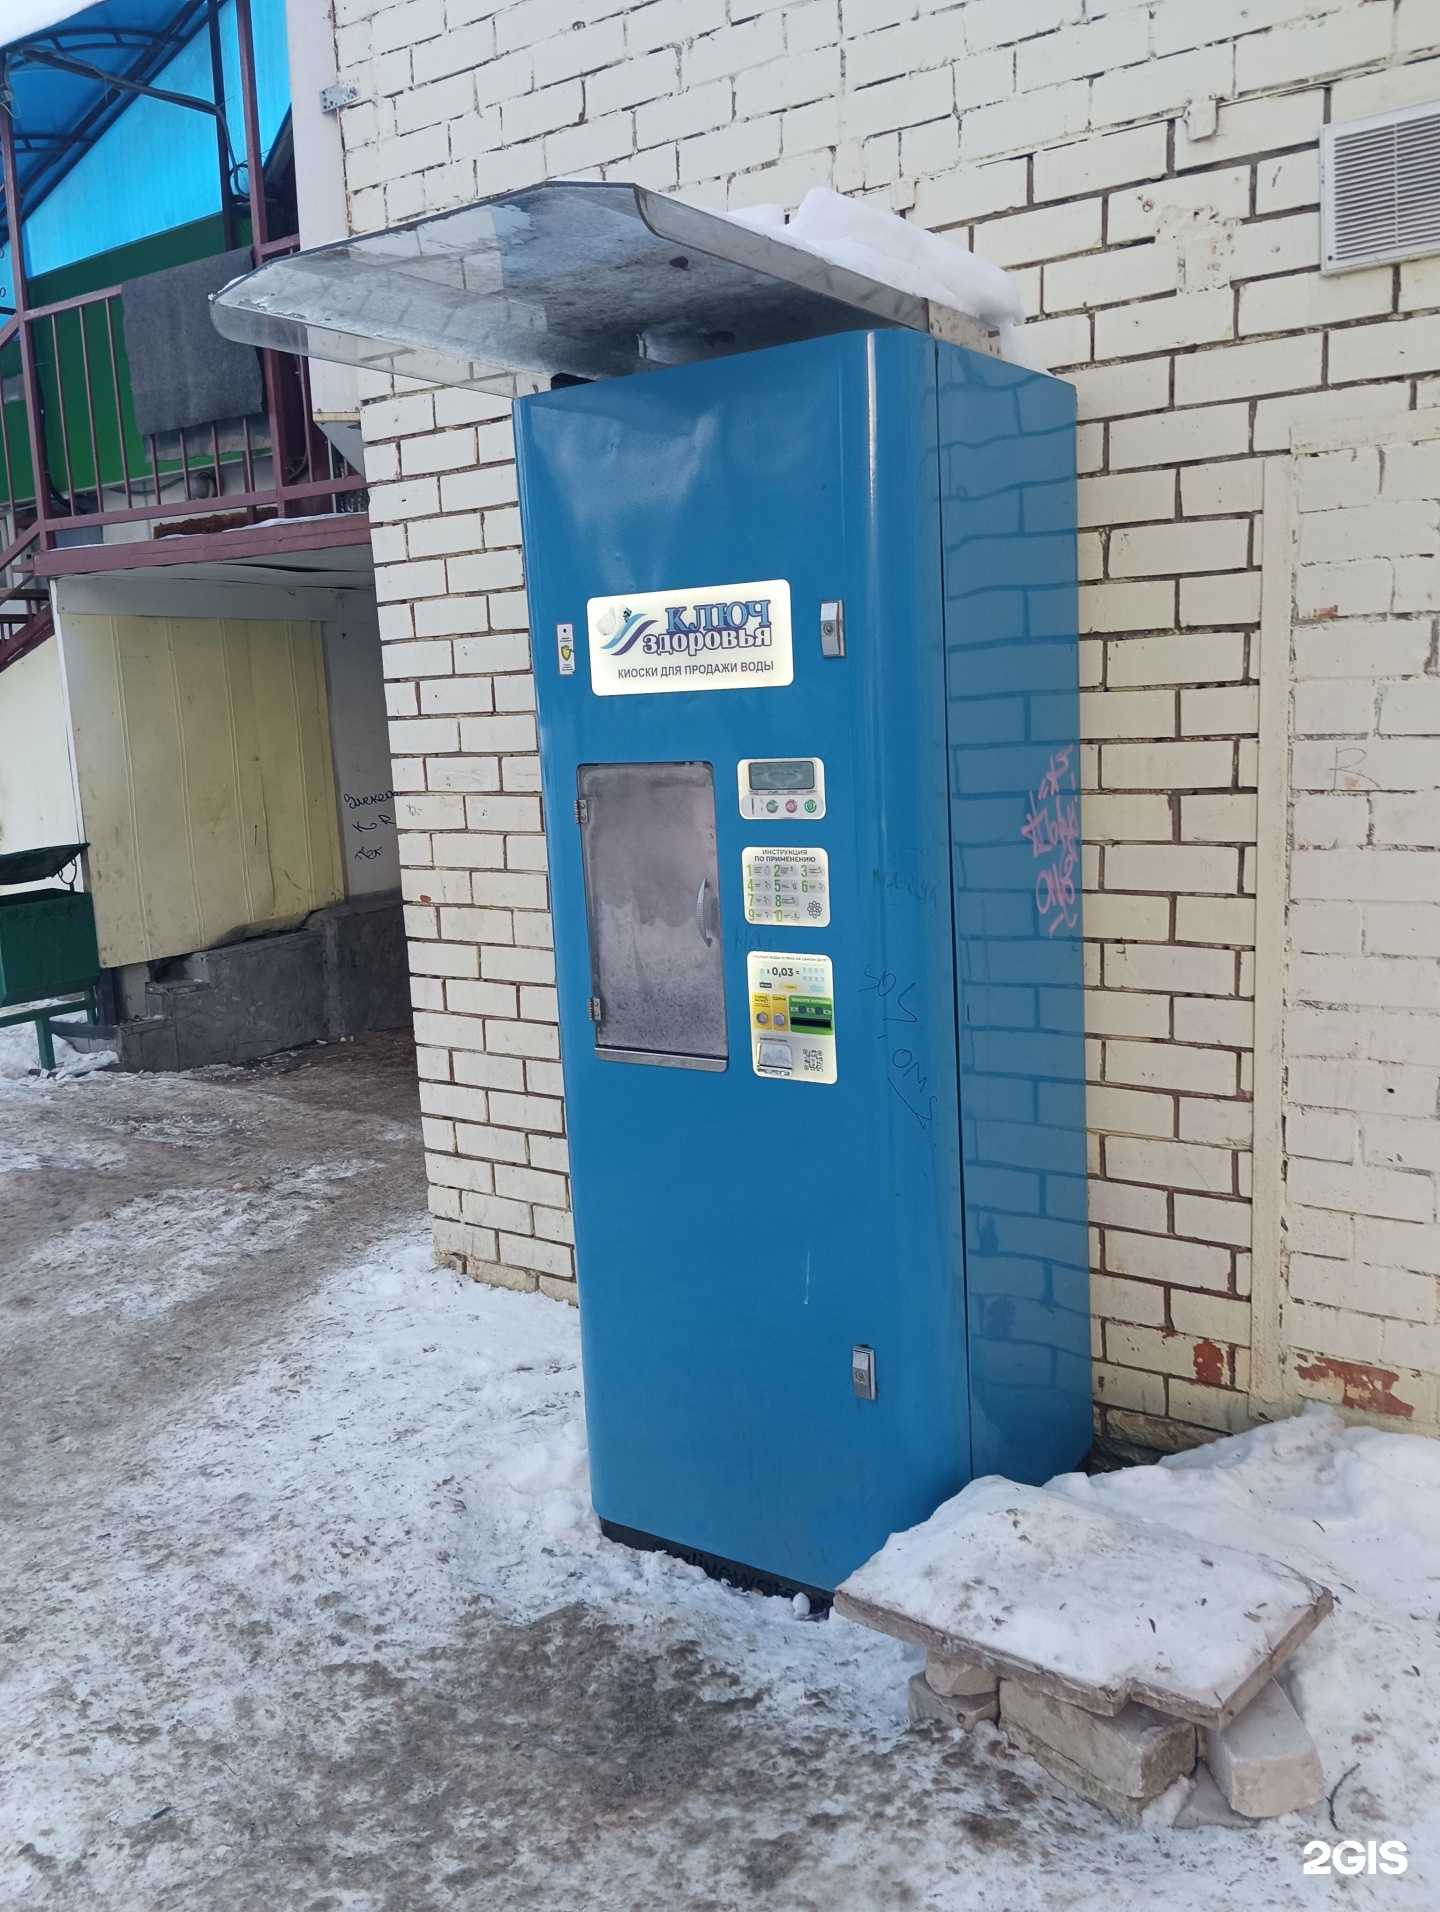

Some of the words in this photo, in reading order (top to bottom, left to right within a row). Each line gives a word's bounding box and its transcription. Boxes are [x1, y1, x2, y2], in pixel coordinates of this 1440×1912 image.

[665, 600, 771, 633] КЛЮЧ
[618, 667, 657, 679] КИОСКИ
[660, 665, 682, 678] ДЛЯ
[684, 662, 738, 675] ПРОДАЖИ
[741, 660, 774, 673] ВОДЫ
[774, 865, 781, 877] 2
[801, 865, 807, 877] 3
[774, 880, 781, 892] 5
[801, 880, 808, 893] 6
[775, 895, 781, 907] 8
[774, 909, 783, 922] 10
[772, 967, 793, 977] 0,03
